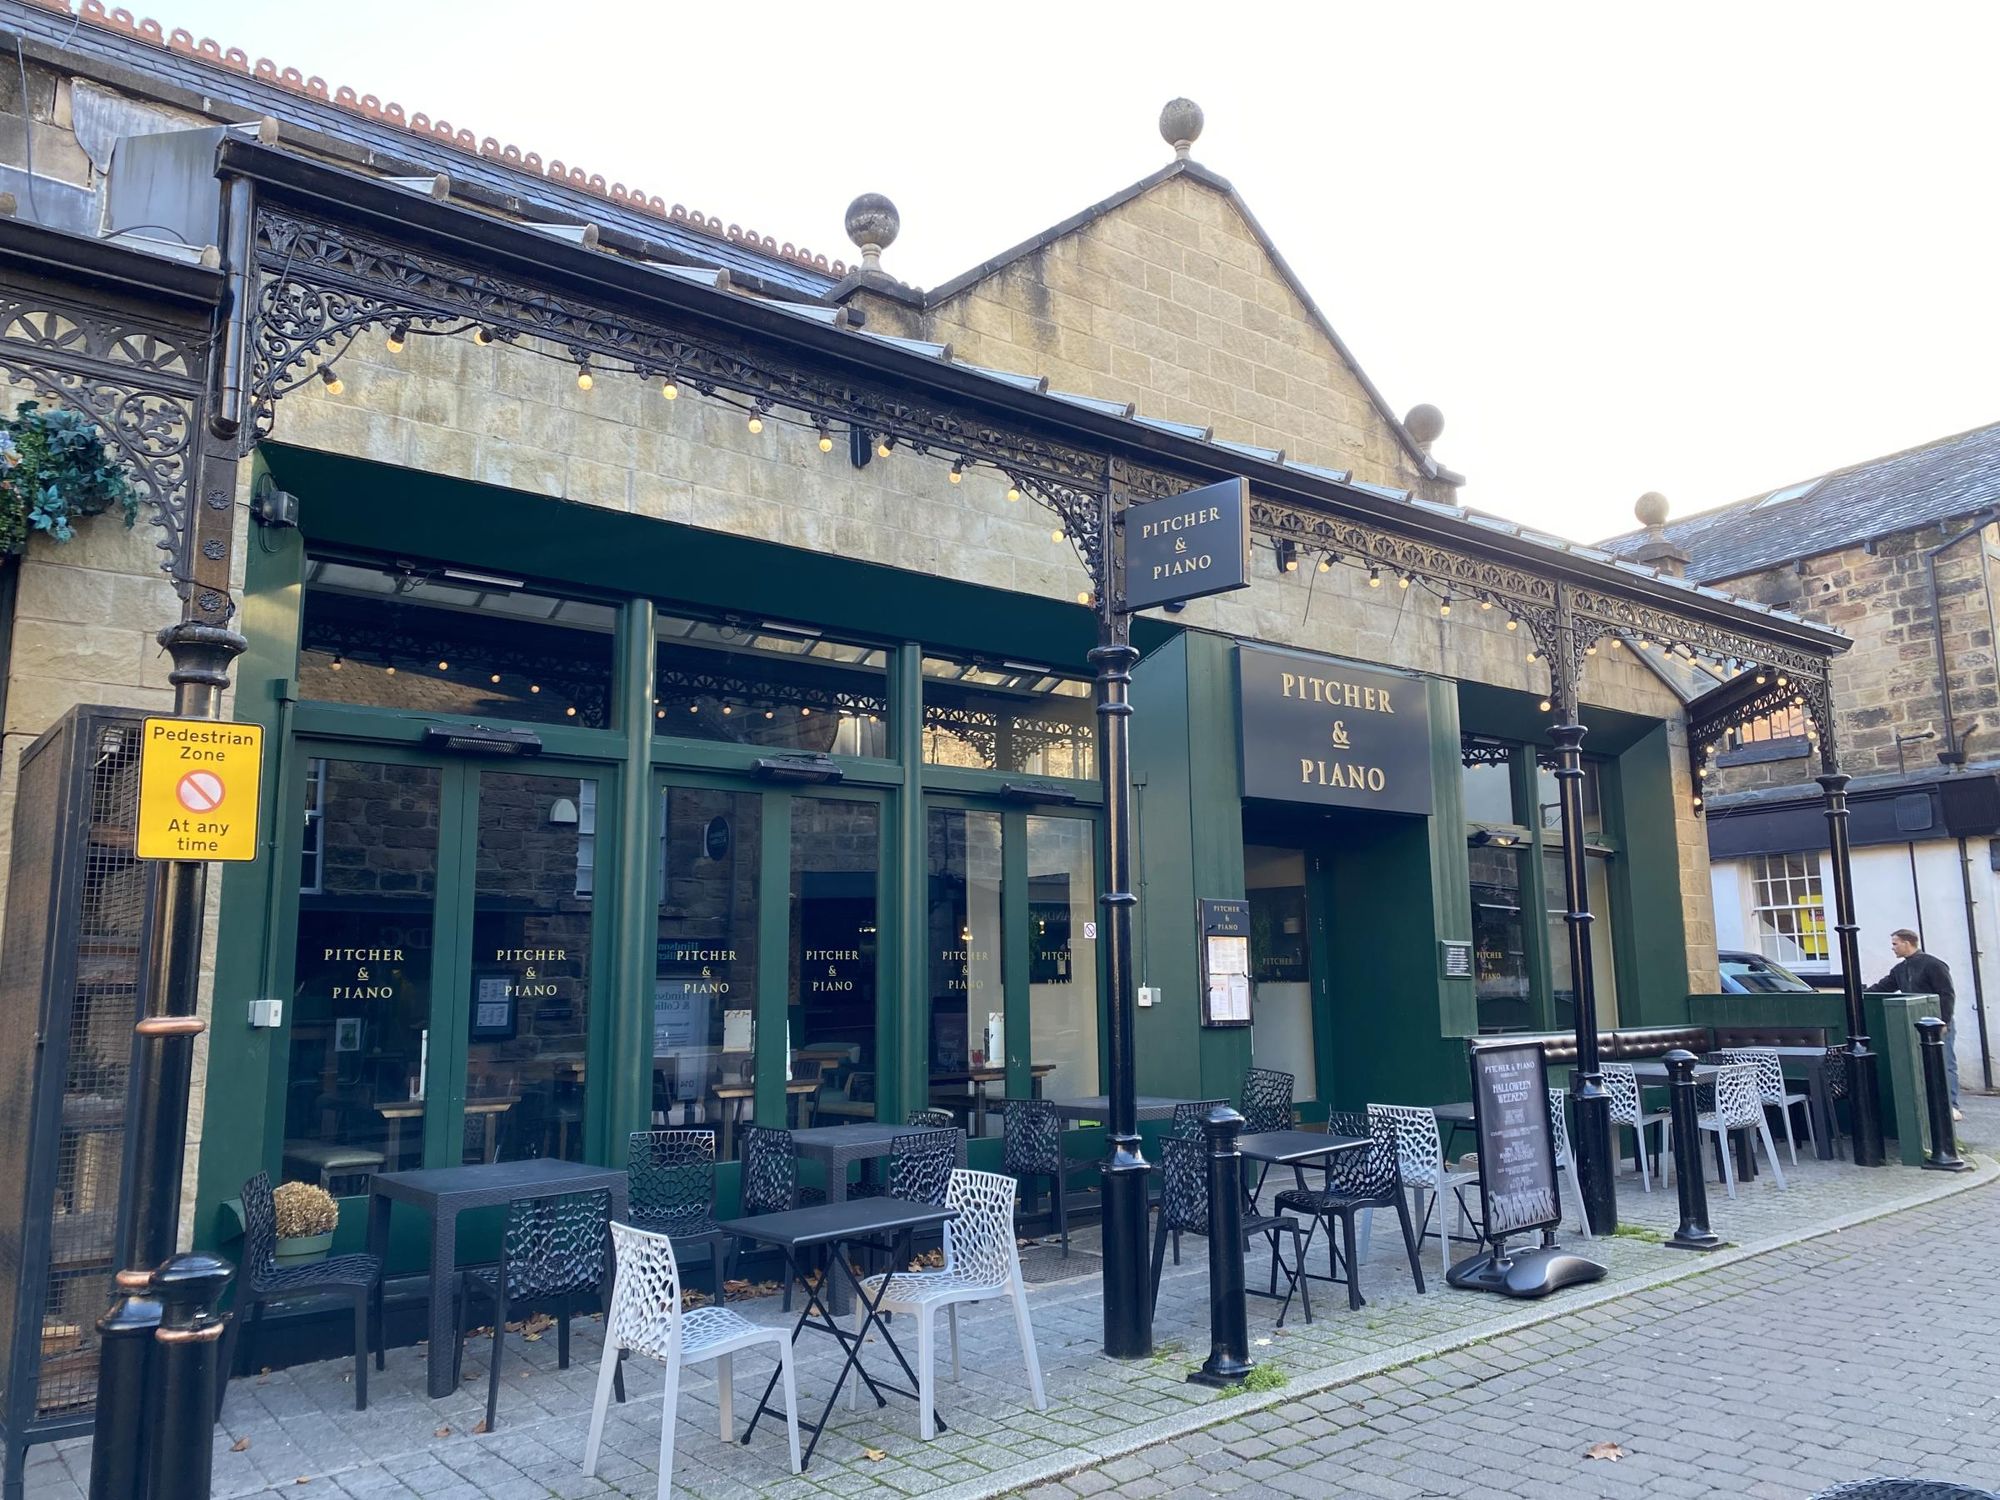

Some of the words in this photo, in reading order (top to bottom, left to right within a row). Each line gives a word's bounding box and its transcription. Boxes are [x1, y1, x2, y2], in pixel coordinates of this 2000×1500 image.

[1142, 506, 1221, 539] PITCHER
[1174, 537, 1187, 554] &
[1153, 554, 1212, 580] PIANO
[1281, 672, 1395, 714] PITCHER
[153, 726, 254, 746] Pedestrian
[1332, 720, 1350, 750] &
[180, 746, 226, 762] Zone
[1300, 759, 1386, 792] PIANO
[168, 818, 190, 833] At
[197, 822, 230, 837] any
[177, 837, 218, 852] time
[323, 949, 404, 962] PITCHER
[496, 950, 567, 961] PITCHER
[676, 950, 737, 961] PITCHER
[806, 950, 860, 961] PITCHER
[942, 951, 989, 961] PITCHER
[1041, 951, 1072, 961] PITCH
[357, 967, 369, 981] &
[525, 966, 537, 980] &
[702, 966, 711, 977] &
[828, 965, 837, 977] &
[961, 964, 969, 976] &
[504, 985, 558, 996] PIANO
[684, 983, 730, 994] PIANO
[812, 981, 853, 991] PIANO
[948, 979, 984, 990] PIANO
[333, 986, 393, 999] PIANO
[1484, 1064, 1510, 1074] PITCHER
[1516, 1060, 1535, 1071] PIANO
[1492, 1079, 1531, 1094] HALLOWEEN
[1497, 1090, 1529, 1104] WEEKEND
